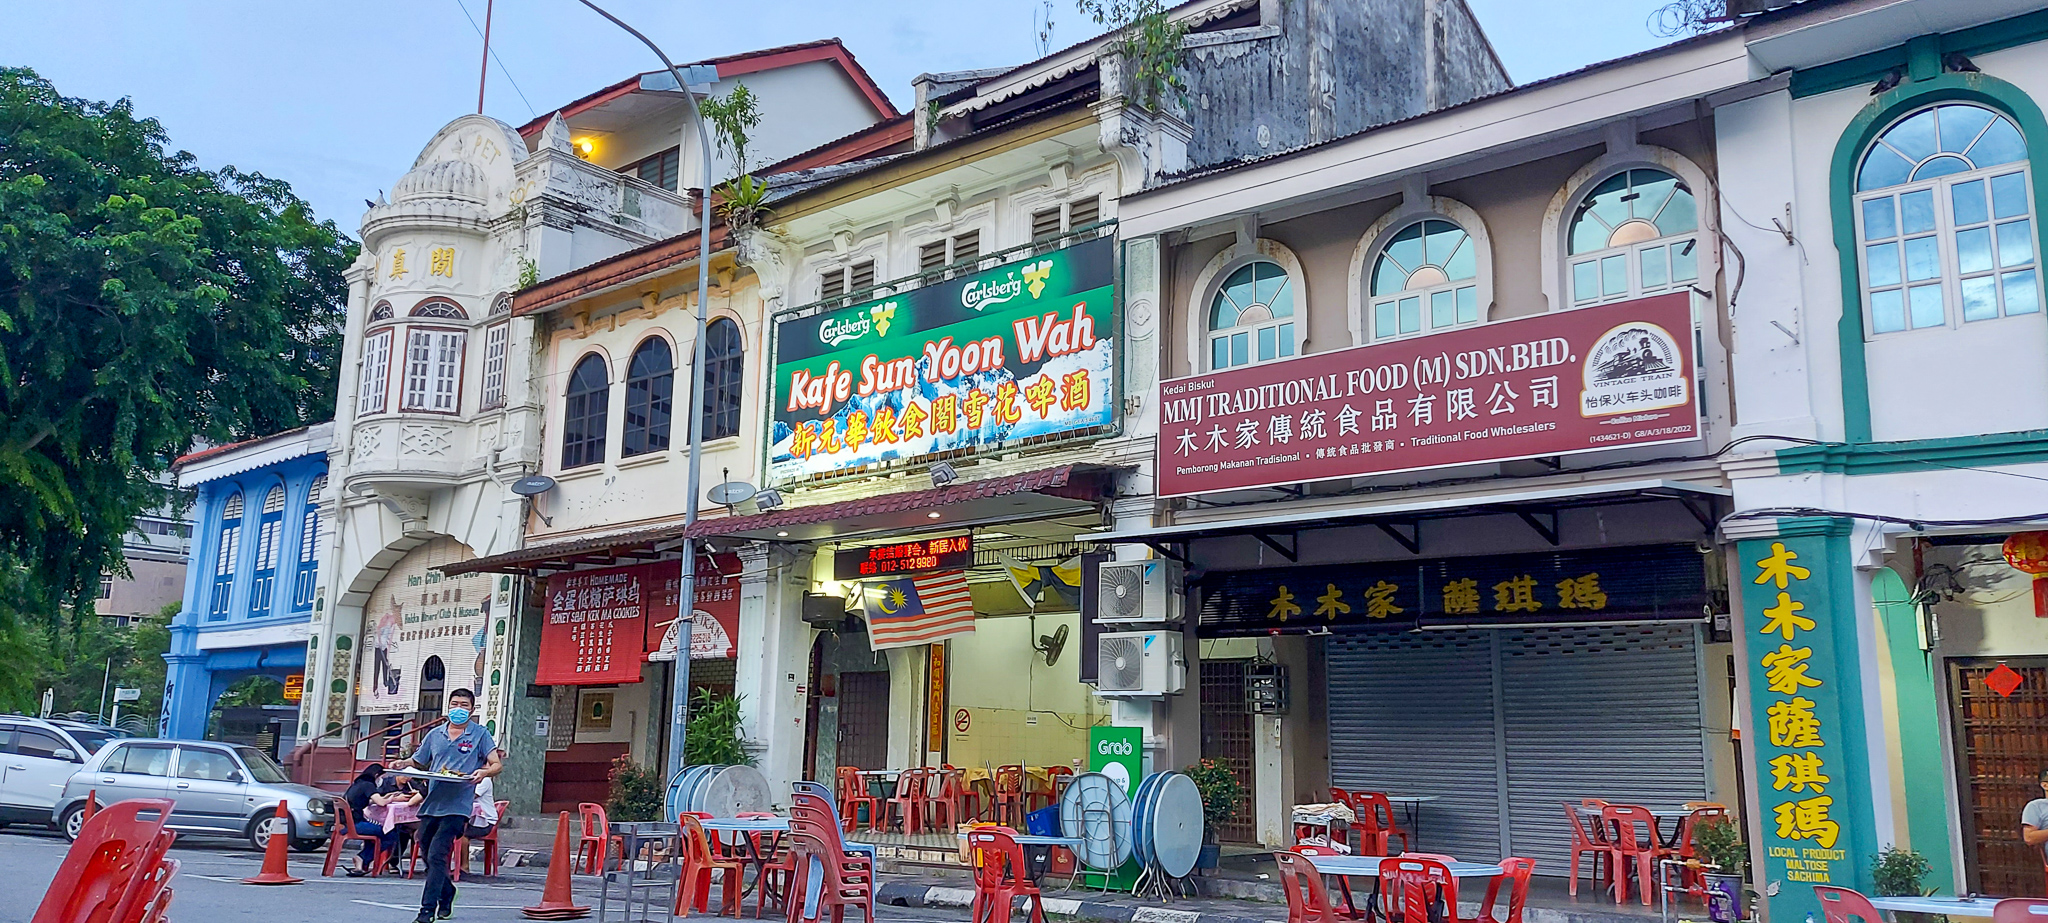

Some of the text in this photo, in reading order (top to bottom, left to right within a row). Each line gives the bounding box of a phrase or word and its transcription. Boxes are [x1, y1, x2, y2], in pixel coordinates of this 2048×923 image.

[961, 274, 1022, 310] Carlsberg
[819, 314, 870, 346] Carlsberg
[788, 302, 1095, 413] Kafe Sun Yoon Wah
[1163, 337, 1576, 426] MMJ TRADITIONAL FOOD (M) SDN.BHD.
[1163, 379, 1215, 396] Kedai Biskut
[1593, 373, 1673, 388] VINTAGE TRAIN
[1586, 385, 1682, 409] 怡保火车头咖啡
[1174, 375, 1559, 458] 木木家傳統食品有限公司
[1411, 422, 1556, 447] Traditional Food Wholesalers
[1176, 452, 1300, 476] Pemborong Makanan Tradisional
[590, 573, 628, 586] HOMEMADE
[601, 608, 612, 620] MA
[613, 605, 640, 619] COOKIES
[1098, 738, 1132, 756] Grab
[1769, 847, 1845, 860] LOCAL PRODUCT
[1786, 859, 1828, 871] MALTOSE
[1787, 870, 1830, 883] SACHIMA
